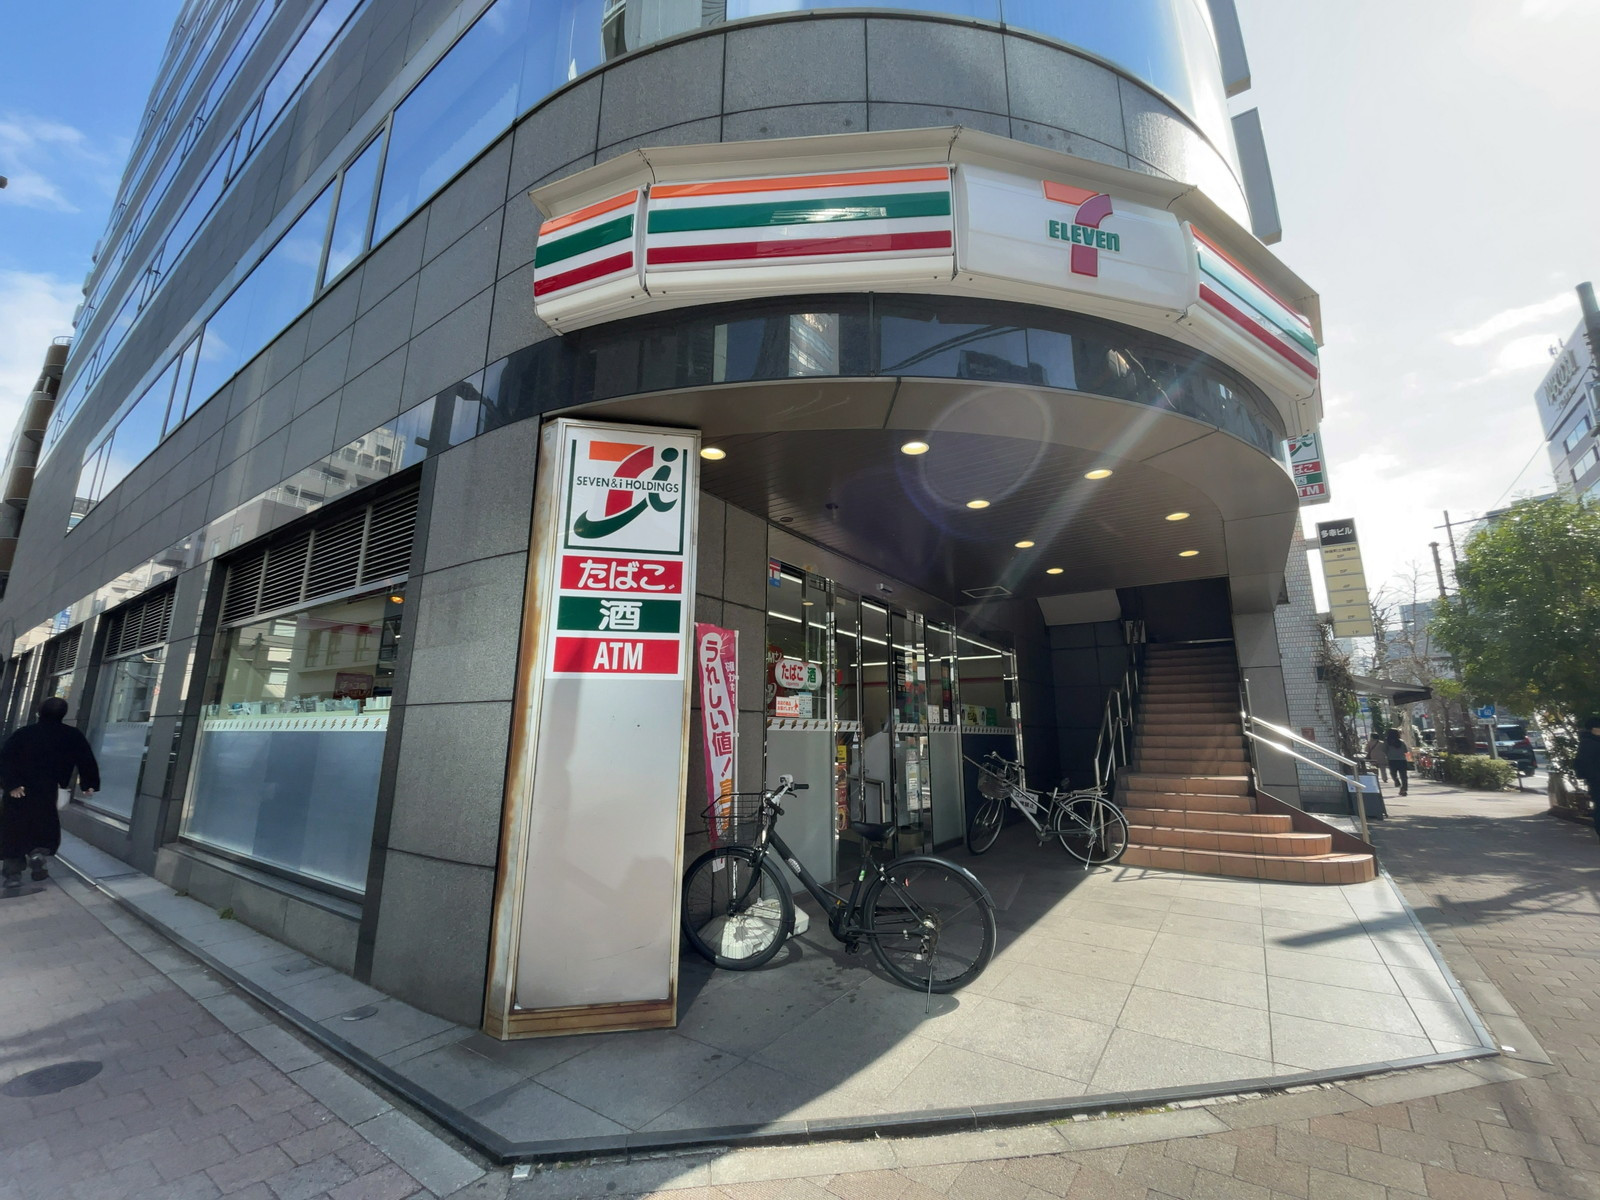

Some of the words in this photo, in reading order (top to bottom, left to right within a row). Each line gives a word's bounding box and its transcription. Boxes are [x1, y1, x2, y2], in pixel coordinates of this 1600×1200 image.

[1048, 219, 1120, 252] ELEVEN
[625, 479, 679, 493] HOLDINGS
[577, 559, 666, 591] たばこ
[598, 599, 643, 630] 酒
[593, 641, 644, 670] ATM
[782, 663, 804, 681] たばこ
[807, 667, 816, 683] 酒
